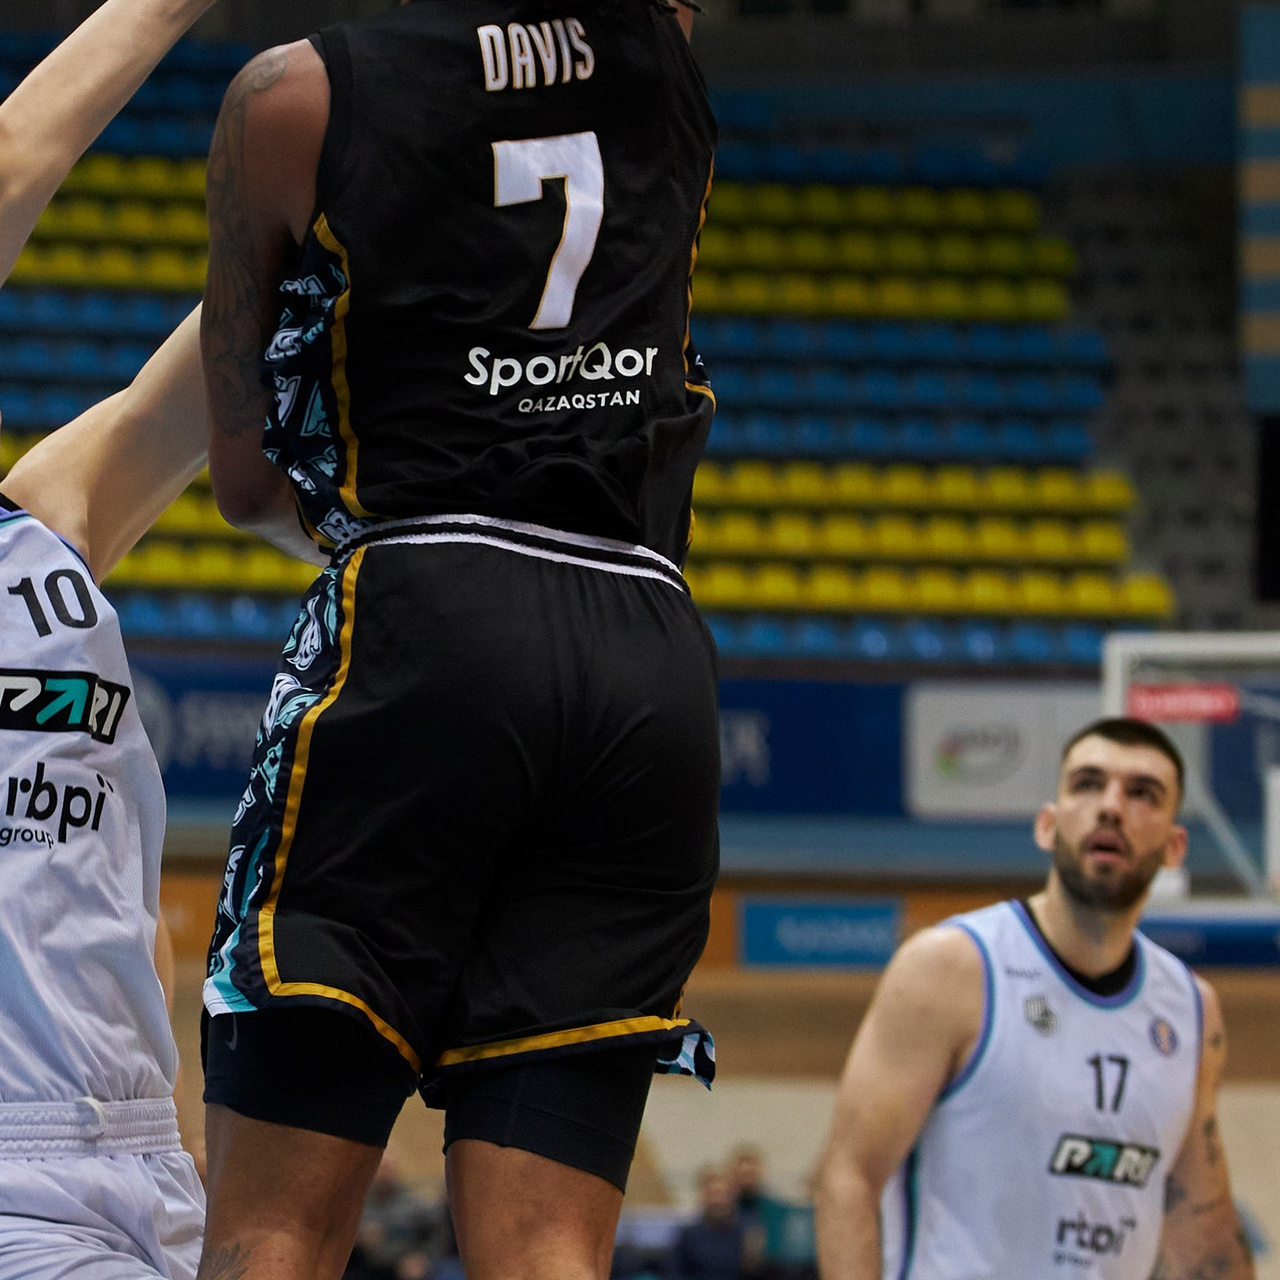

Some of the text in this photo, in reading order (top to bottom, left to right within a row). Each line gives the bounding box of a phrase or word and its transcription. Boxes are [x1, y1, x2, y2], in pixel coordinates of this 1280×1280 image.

[476, 17, 595, 92] DAVIS
[491, 131, 604, 330] 7
[463, 340, 658, 396] SportQor
[518, 389, 641, 414] QAZAQSTAN
[7, 569, 98, 638] 10
[1088, 1053, 1130, 1115] 17
